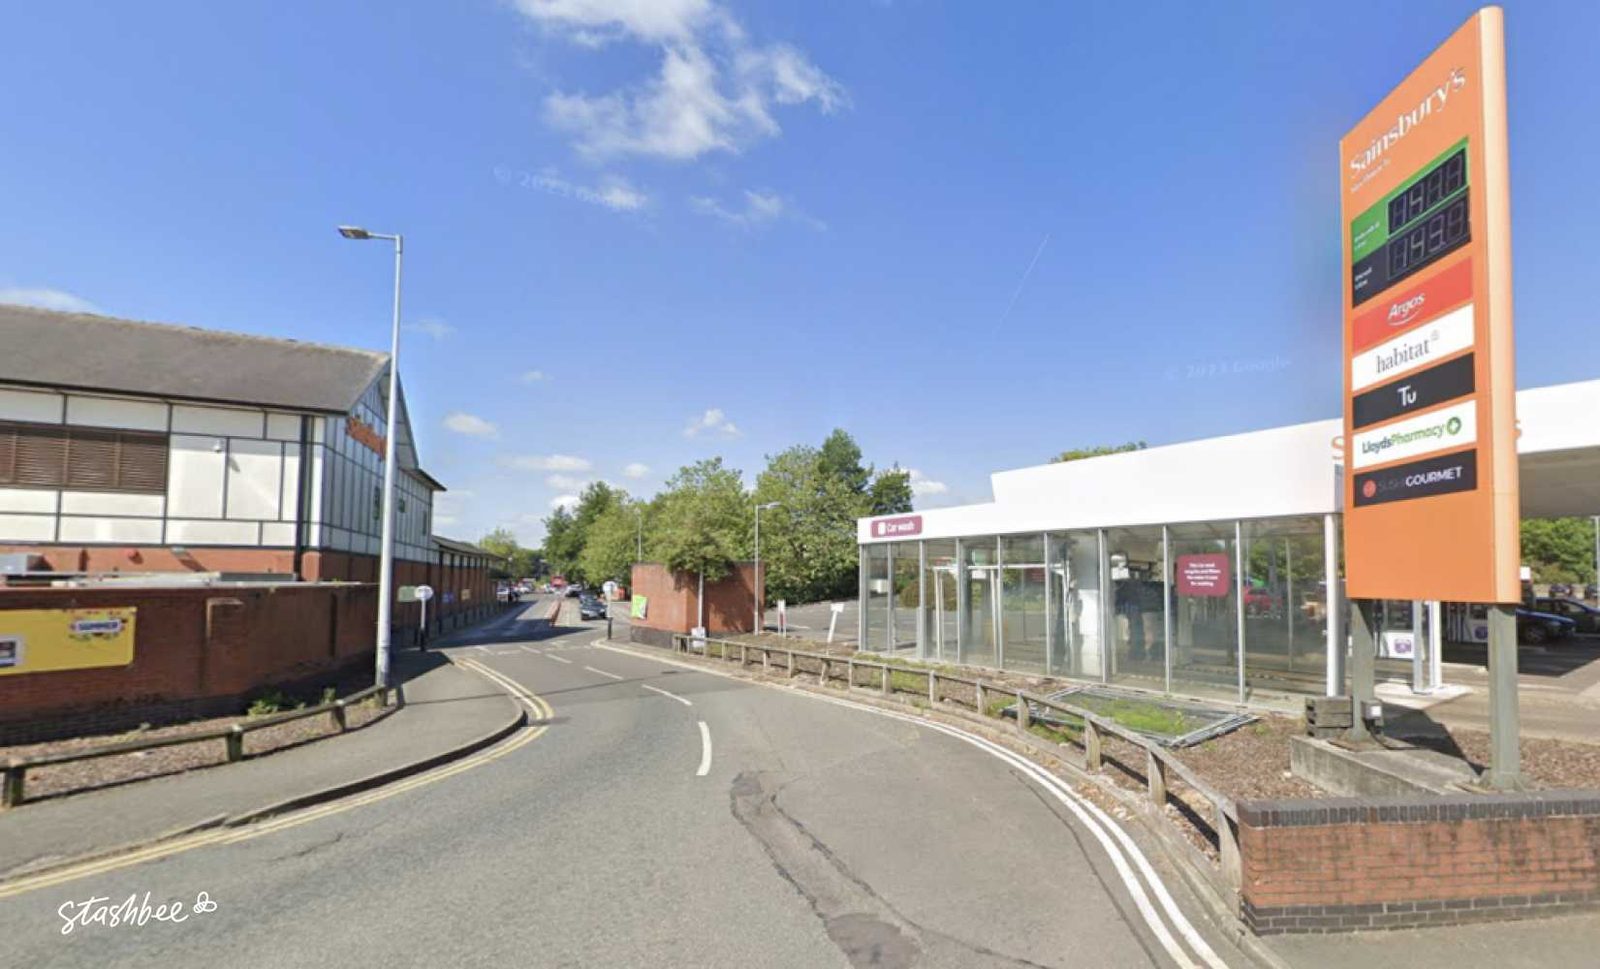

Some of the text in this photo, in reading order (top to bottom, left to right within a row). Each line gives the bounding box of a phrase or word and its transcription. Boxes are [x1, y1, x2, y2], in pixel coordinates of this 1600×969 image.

[1349, 66, 1466, 179] Sainsbury's
[1388, 293, 1425, 320] Argos
[1376, 339, 1430, 374] habitat
[1397, 384, 1417, 407] Tu
[1362, 422, 1446, 455] LloydsPharmacy
[1405, 466, 1463, 488] GOURMET
